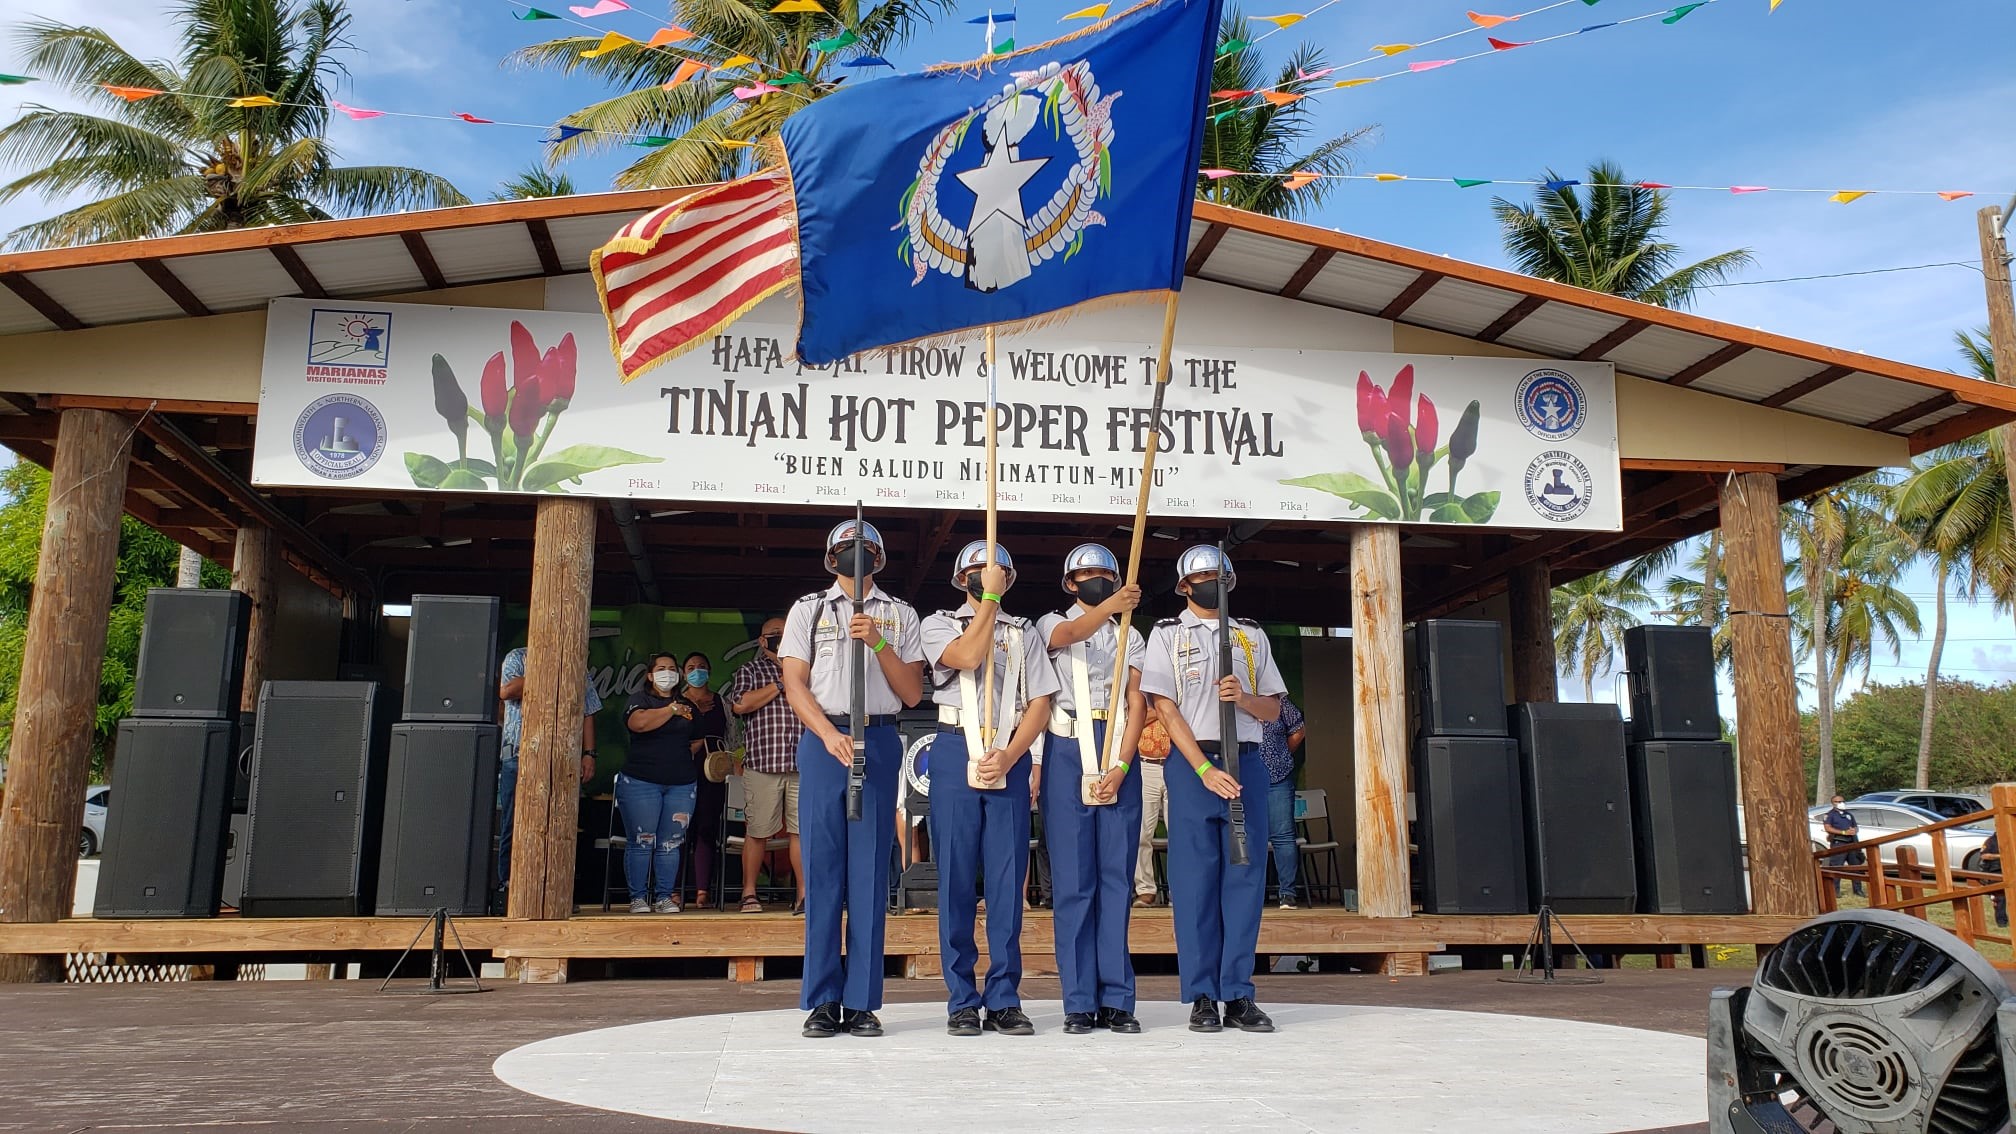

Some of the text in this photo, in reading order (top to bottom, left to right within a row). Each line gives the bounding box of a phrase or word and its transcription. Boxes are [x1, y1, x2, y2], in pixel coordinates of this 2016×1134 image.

[306, 366, 387, 379] MARIANAS
[712, 335, 784, 374] HAFA
[885, 343, 966, 380] TIROW
[1008, 349, 1127, 389] WELCOME
[1185, 359, 1237, 394] THE
[295, 406, 316, 460] COMMONWEALTH
[325, 396, 362, 406] NORTHERN
[364, 404, 384, 431] MARIANA
[660, 380, 1284, 466] TINIAN HOT PEPPER FESTIVAL
[314, 453, 361, 468] OFFICIAL SEAL
[859, 458, 944, 480] SALUDU
